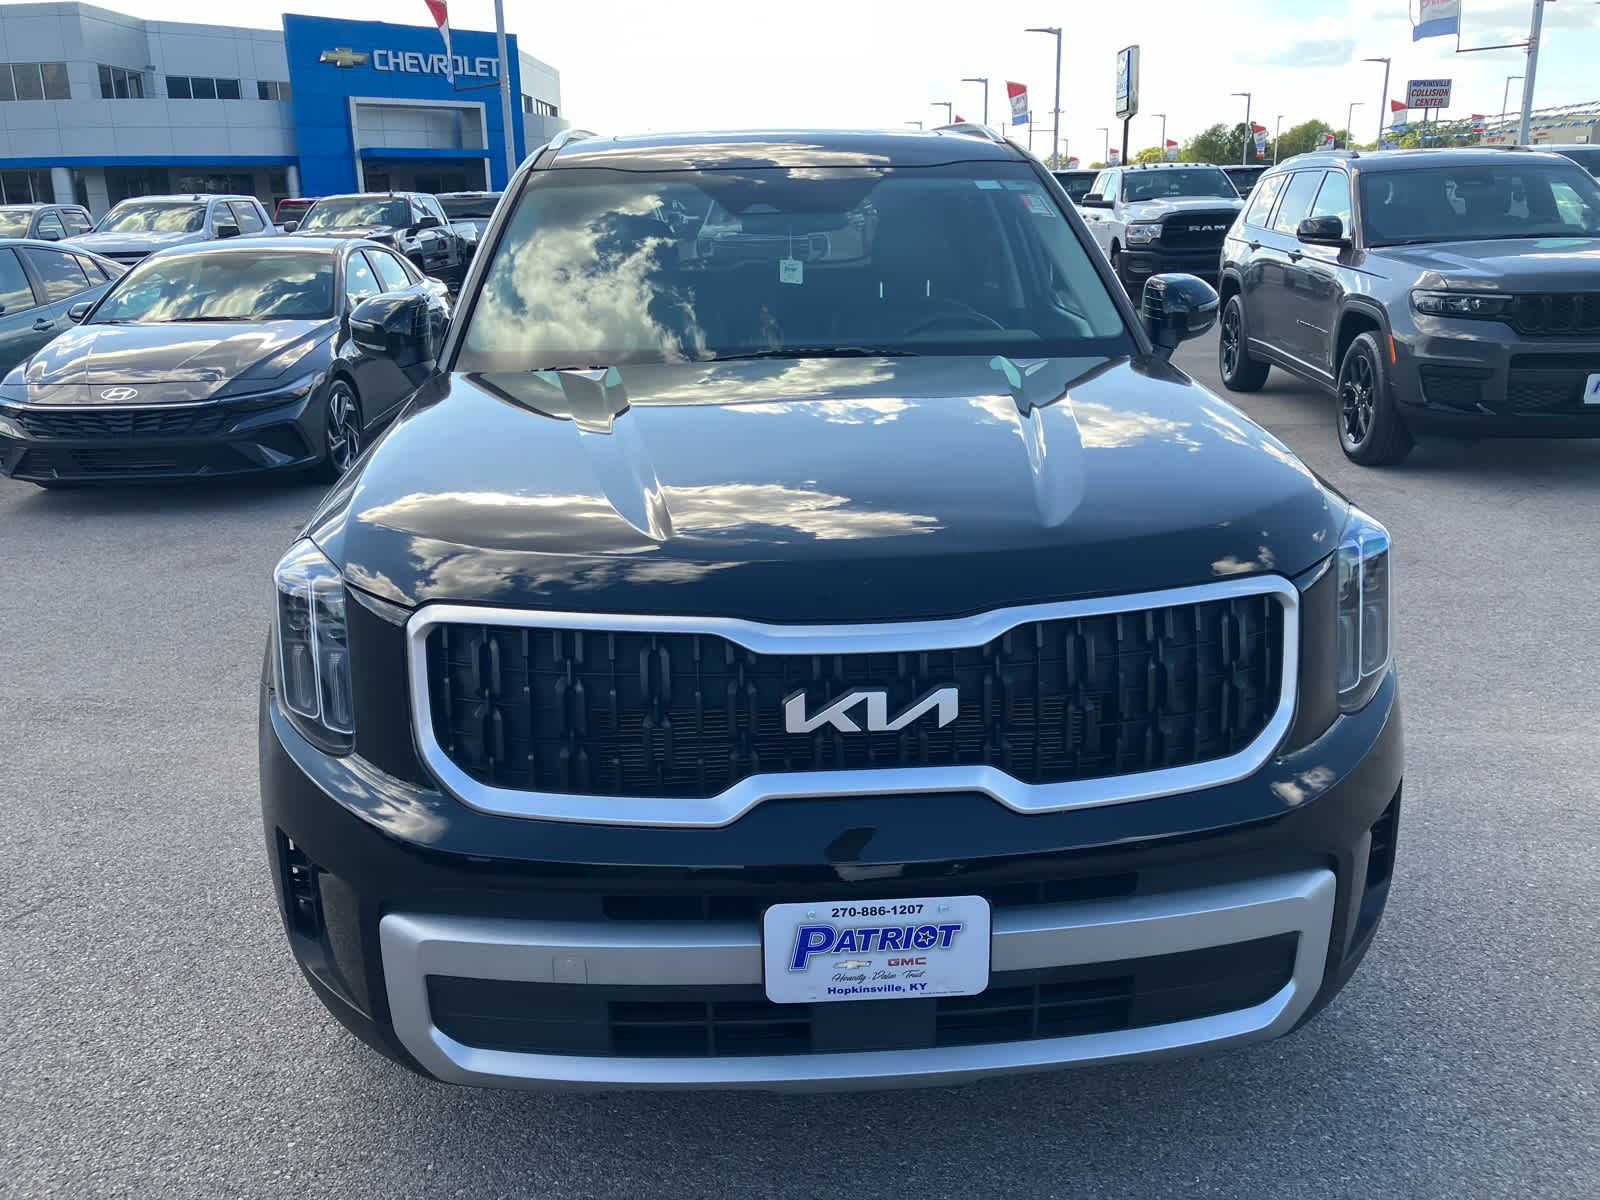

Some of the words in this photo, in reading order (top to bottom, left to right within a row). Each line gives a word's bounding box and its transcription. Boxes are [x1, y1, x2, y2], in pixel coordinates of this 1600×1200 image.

[1411, 88, 1449, 97] COLLISION
[1415, 98, 1444, 107] CENTER
[785, 687, 959, 734] KIA
[831, 904, 924, 918] 270-886-1207
[788, 923, 963, 972] PATRIOT
[887, 957, 927, 967] GMC
[827, 984, 906, 996] Hopkinsville,
[909, 983, 928, 991] KY
